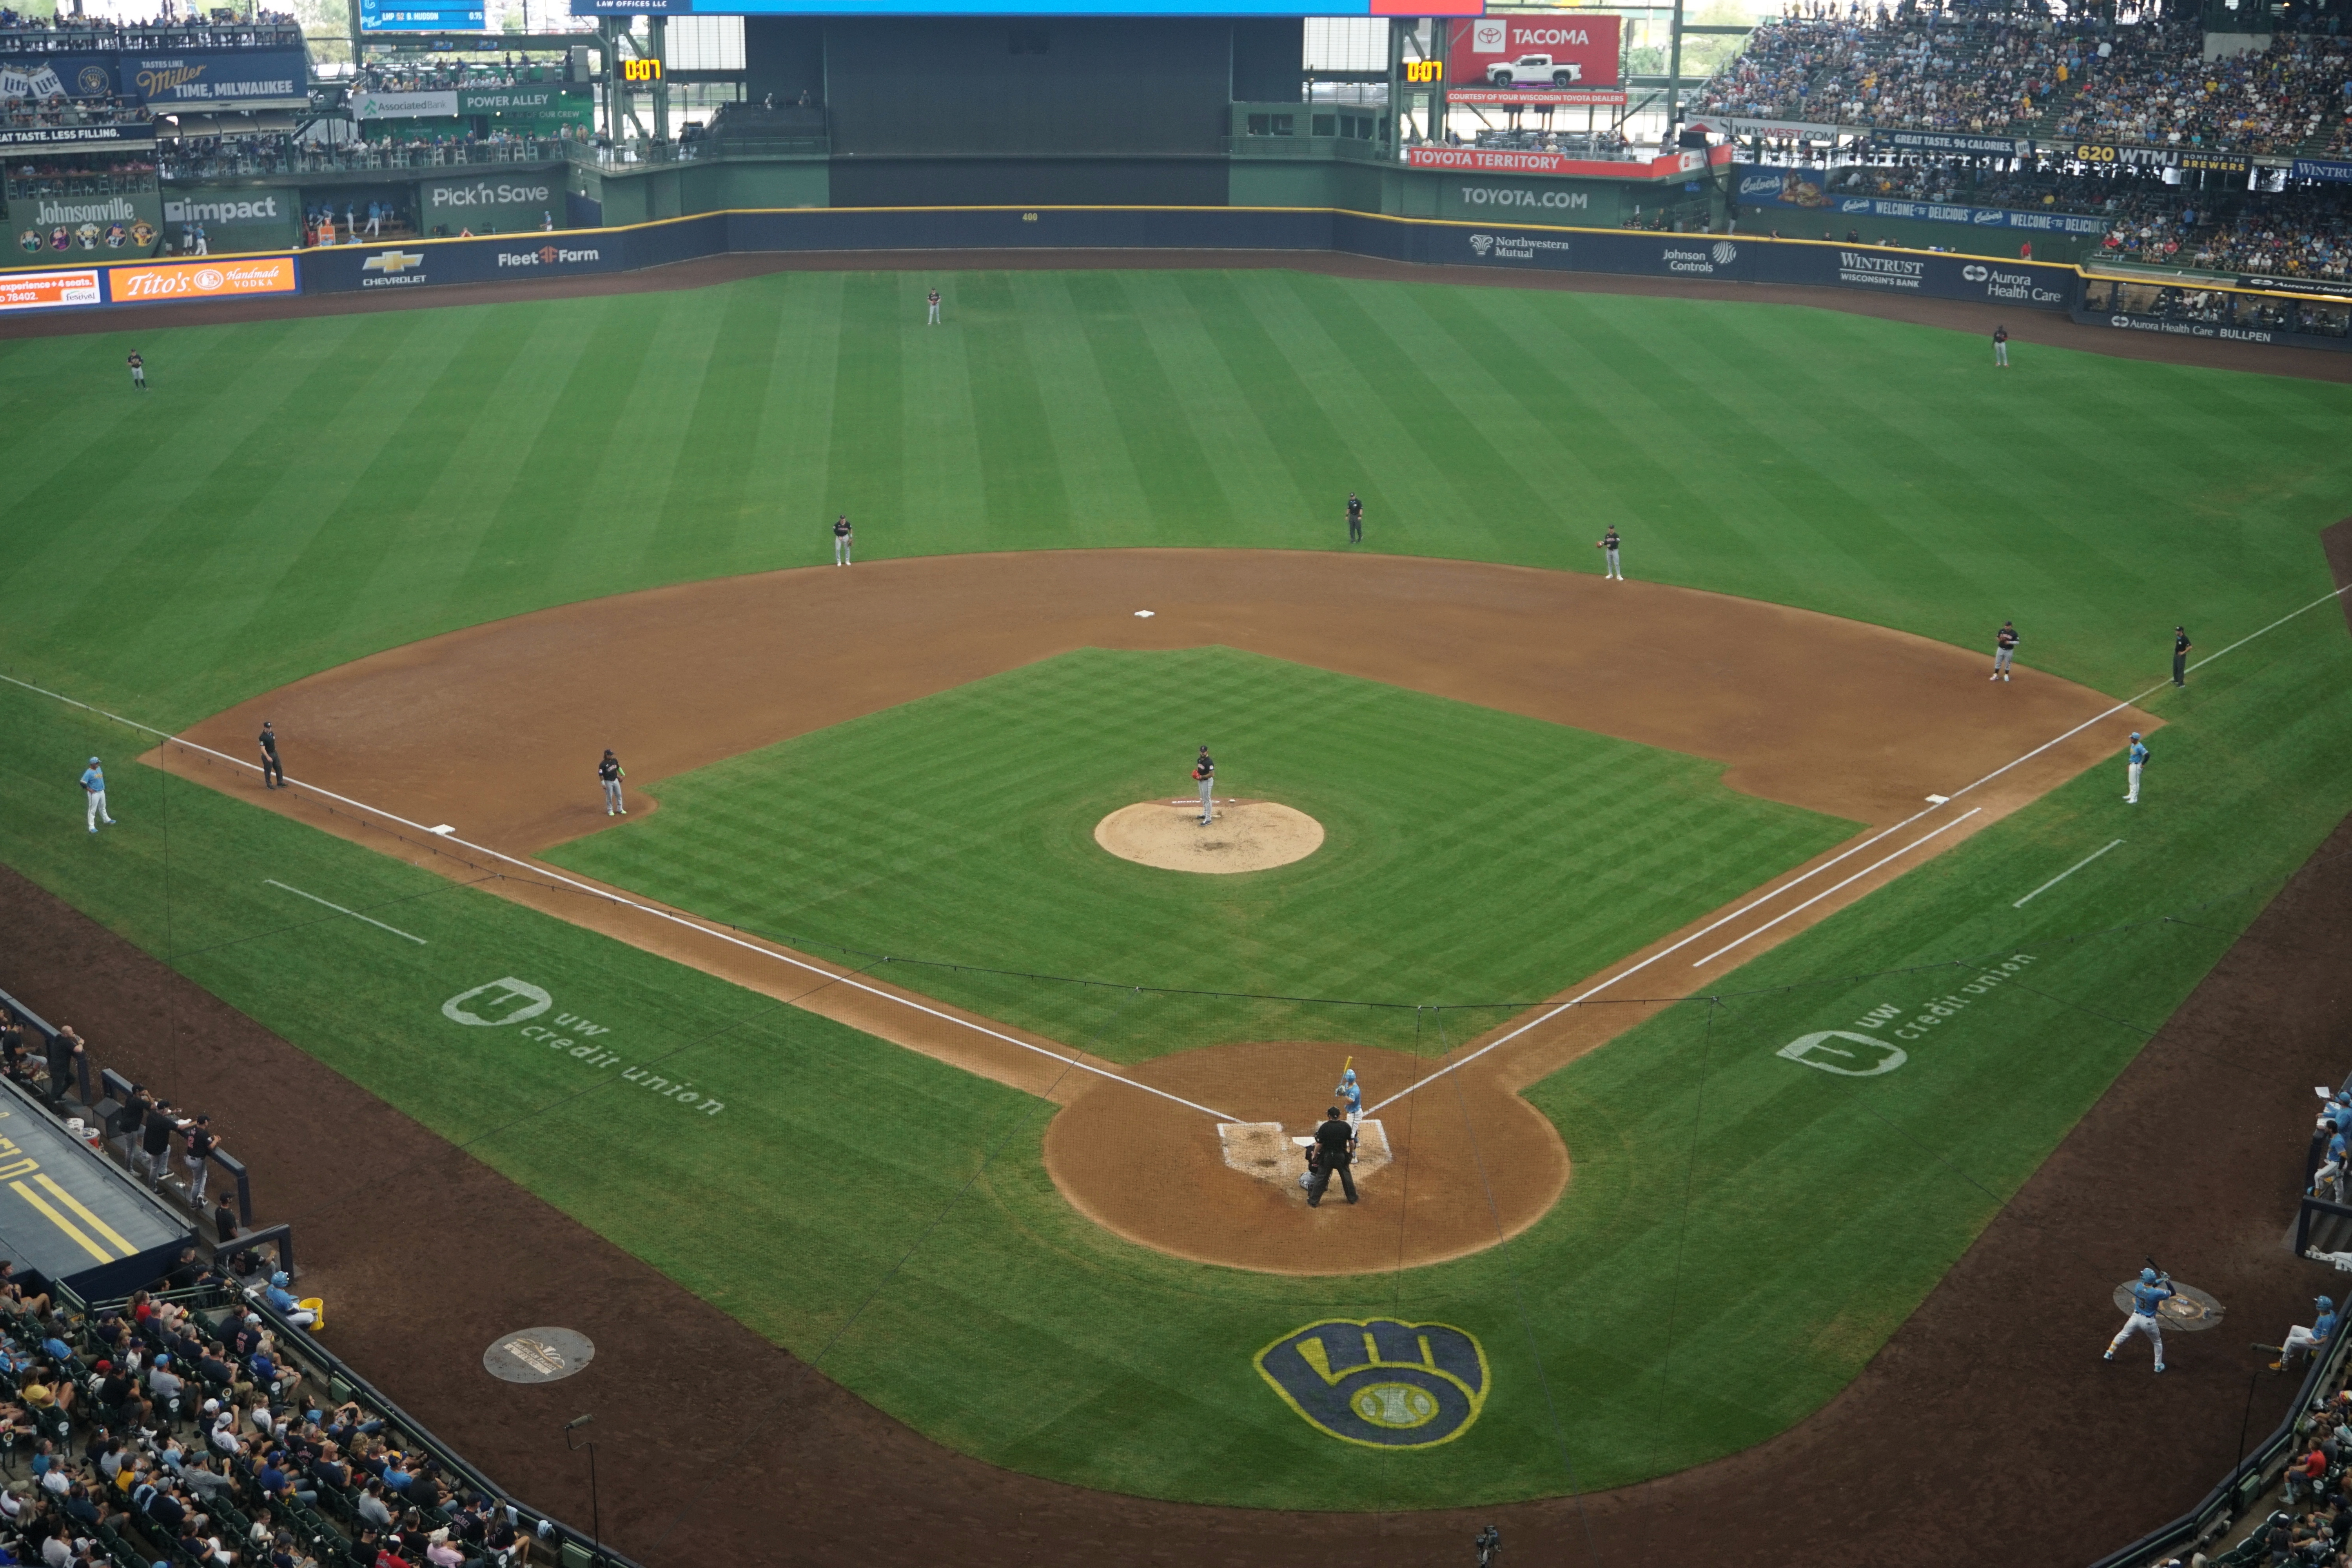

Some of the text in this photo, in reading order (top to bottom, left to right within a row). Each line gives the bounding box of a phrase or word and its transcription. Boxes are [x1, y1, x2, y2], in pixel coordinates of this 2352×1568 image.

[1513, 29, 1589, 45] TACOMA
[626, 59, 661, 80] 0:07
[1407, 61, 1442, 82] 0:07
[4, 76, 27, 93] Lite
[34, 73, 58, 94] Lite
[136, 64, 207, 97] Miller
[174, 80, 293, 98] TIME, MILWAUKEE
[378, 99, 446, 111] Associated Bank
[467, 94, 548, 108] POWER ALLEY
[15, 132, 50, 141] TASTE.
[52, 130, 76, 140] LESS
[78, 129, 120, 138] FILLING.
[1720, 118, 1835, 142] ShoreWEST.COM
[1895, 134, 1922, 144] GREAT
[1924, 136, 1952, 147] TASTE.
[1954, 139, 1966, 148] 96
[1967, 140, 2013, 152] CALORIES.
[1414, 151, 1559, 169] TOYOTA TERRITORY
[2078, 145, 2178, 167] 620 WTMJ
[2182, 161, 2245, 172] BREWERS
[498, 185, 549, 203] Save
[1740, 176, 1781, 195] Culver's
[1463, 188, 1587, 209] TOYOTA.COM
[36, 197, 136, 225] Johnsonville
[184, 196, 276, 223] impact
[1876, 201, 1915, 216] WELCOME
[1928, 206, 1968, 221] DELICIOUS
[2011, 213, 2051, 229] WELCOME
[1495, 236, 1569, 250] Northwestern
[498, 249, 599, 267] Fleet Farm
[1495, 247, 1533, 258] Mutual
[1663, 248, 1706, 261] Johnson
[1670, 260, 1713, 272] Controls
[1840, 252, 1924, 275] WINTRUST
[226, 266, 279, 280] Handmade
[363, 275, 427, 287] CHEVROLET
[1841, 273, 1894, 285] WISCONSIN'S
[1989, 271, 2031, 285] Aurora
[0, 281, 51, 292] experience
[127, 272, 191, 296] Tito's
[234, 279, 273, 288] VODKA
[2274, 282, 2314, 290] Aurora
[7, 292, 38, 302] 78402.
[66, 292, 95, 301] festival
[1987, 283, 2061, 303] Health Care
[2130, 319, 2271, 342] Aurora Health Care BULLPEN
[1894, 953, 2036, 1040] credit union
[520, 1024, 725, 1116] credit union
[2139, 1298, 2146, 1309] 3
